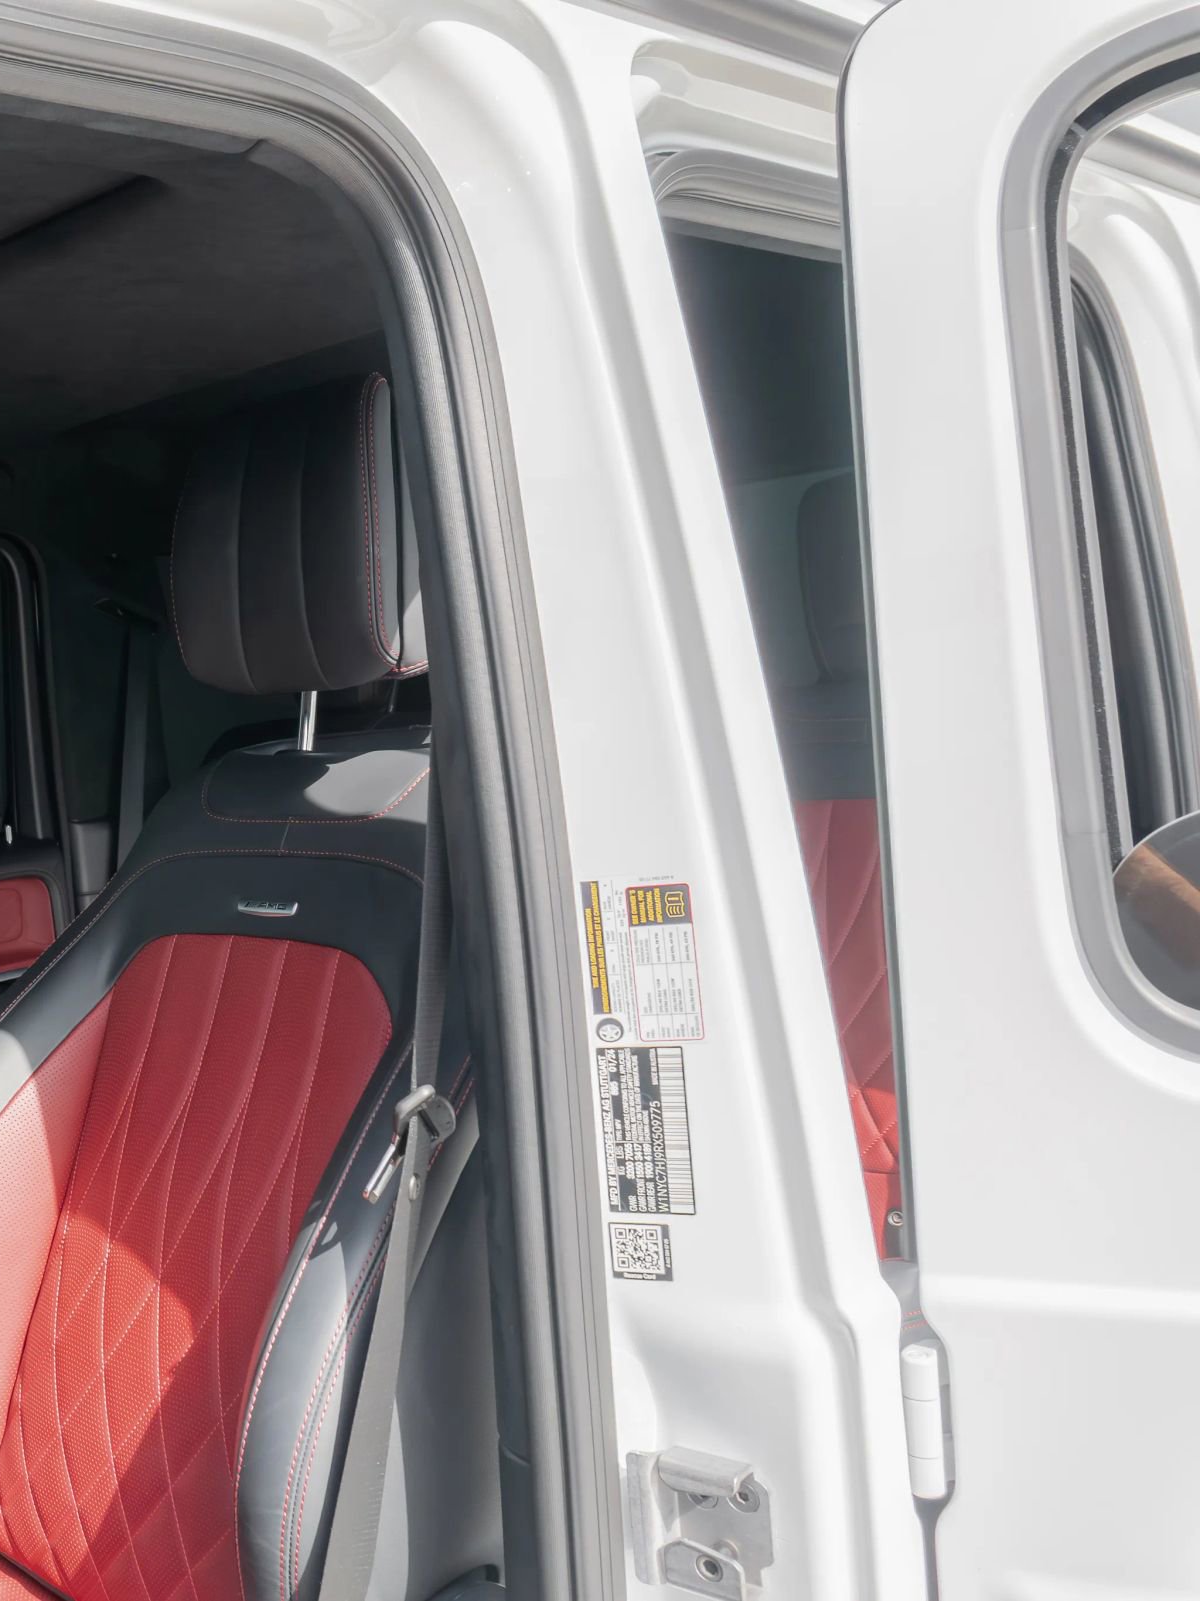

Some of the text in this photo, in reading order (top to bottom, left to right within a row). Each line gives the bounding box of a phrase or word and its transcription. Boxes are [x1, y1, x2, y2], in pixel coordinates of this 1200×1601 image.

[606, 1049, 618, 1073] 01/24
[598, 1055, 619, 1205] MFD BY MERCEDES-BENZ AG STUTTGART
[616, 1146, 624, 1159] LBS
[650, 1101, 670, 1213] W1NYC7HJ9RX509775
